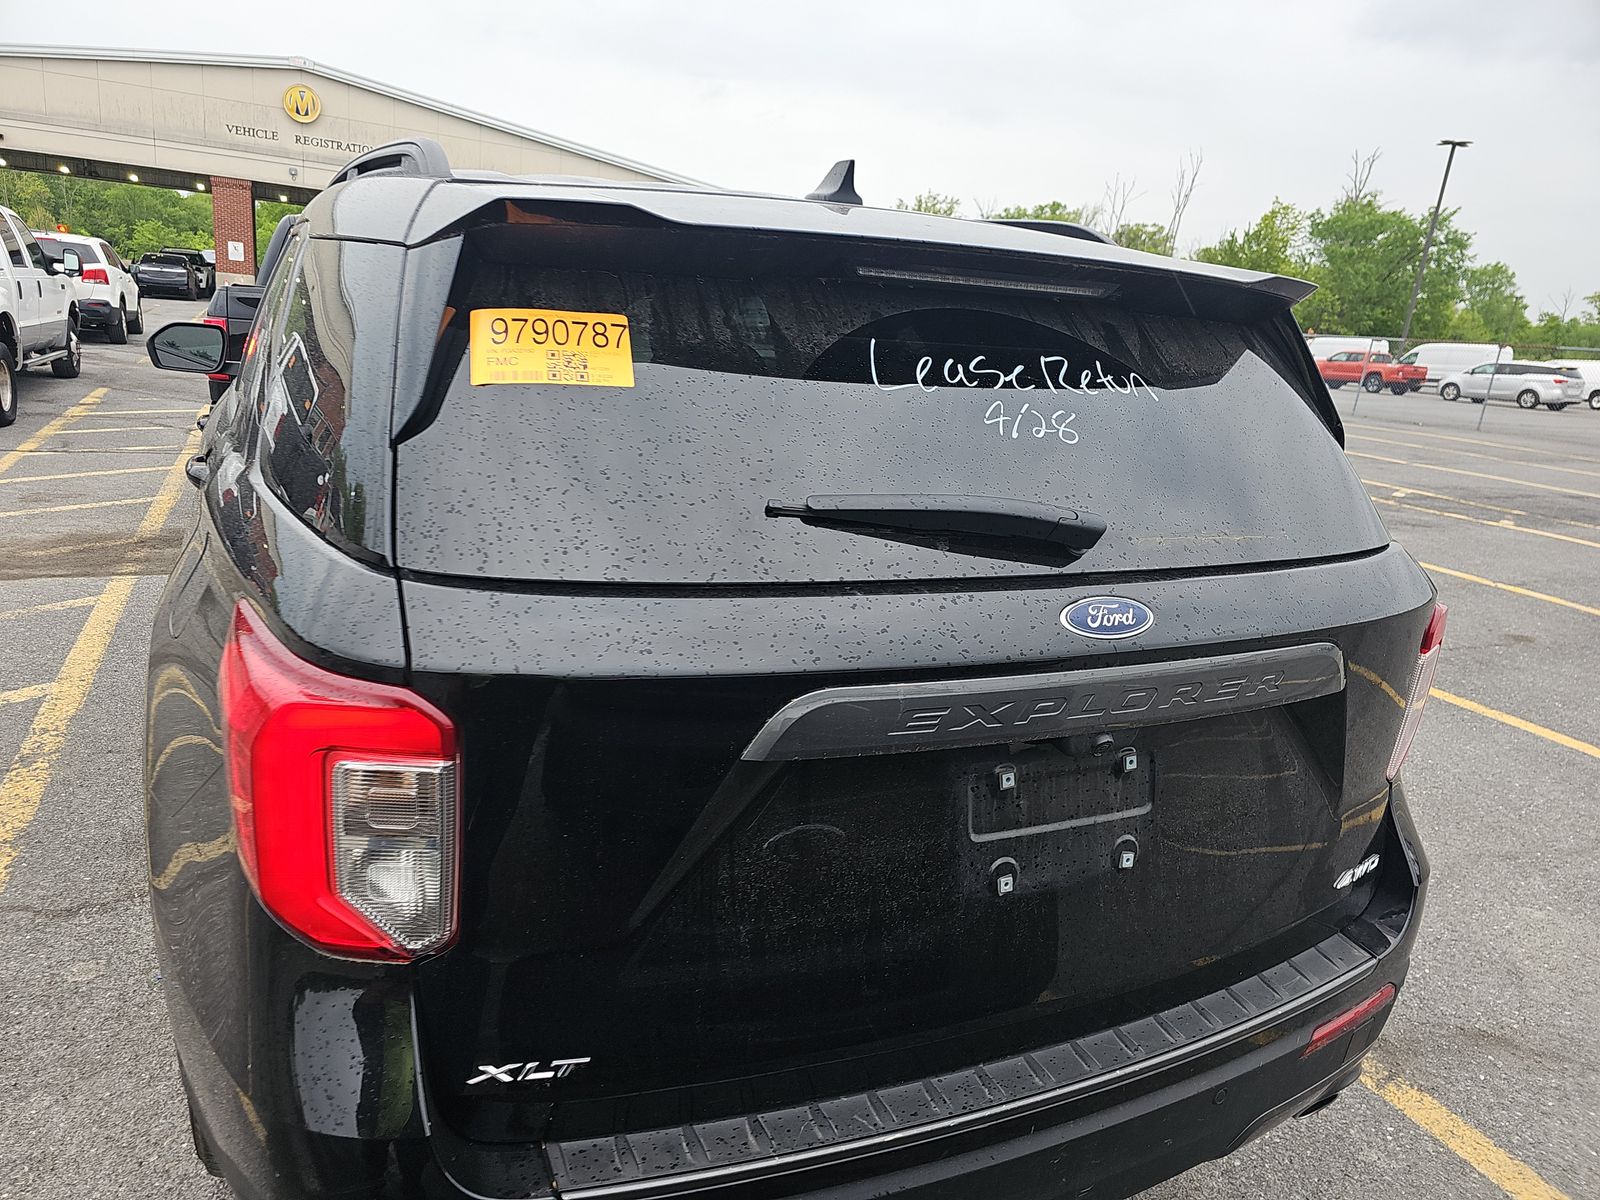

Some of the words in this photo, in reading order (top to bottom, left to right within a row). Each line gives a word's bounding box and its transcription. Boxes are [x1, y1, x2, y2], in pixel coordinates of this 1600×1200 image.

[225, 124, 279, 141] VEHICLE
[294, 134, 374, 154] REGISTRATIO
[491, 317, 628, 349] 9790787
[486, 356, 519, 366] FMC
[1086, 604, 1137, 628] Ford
[888, 670, 1286, 736] EXPLORER
[465, 1056, 592, 1085] XLT
